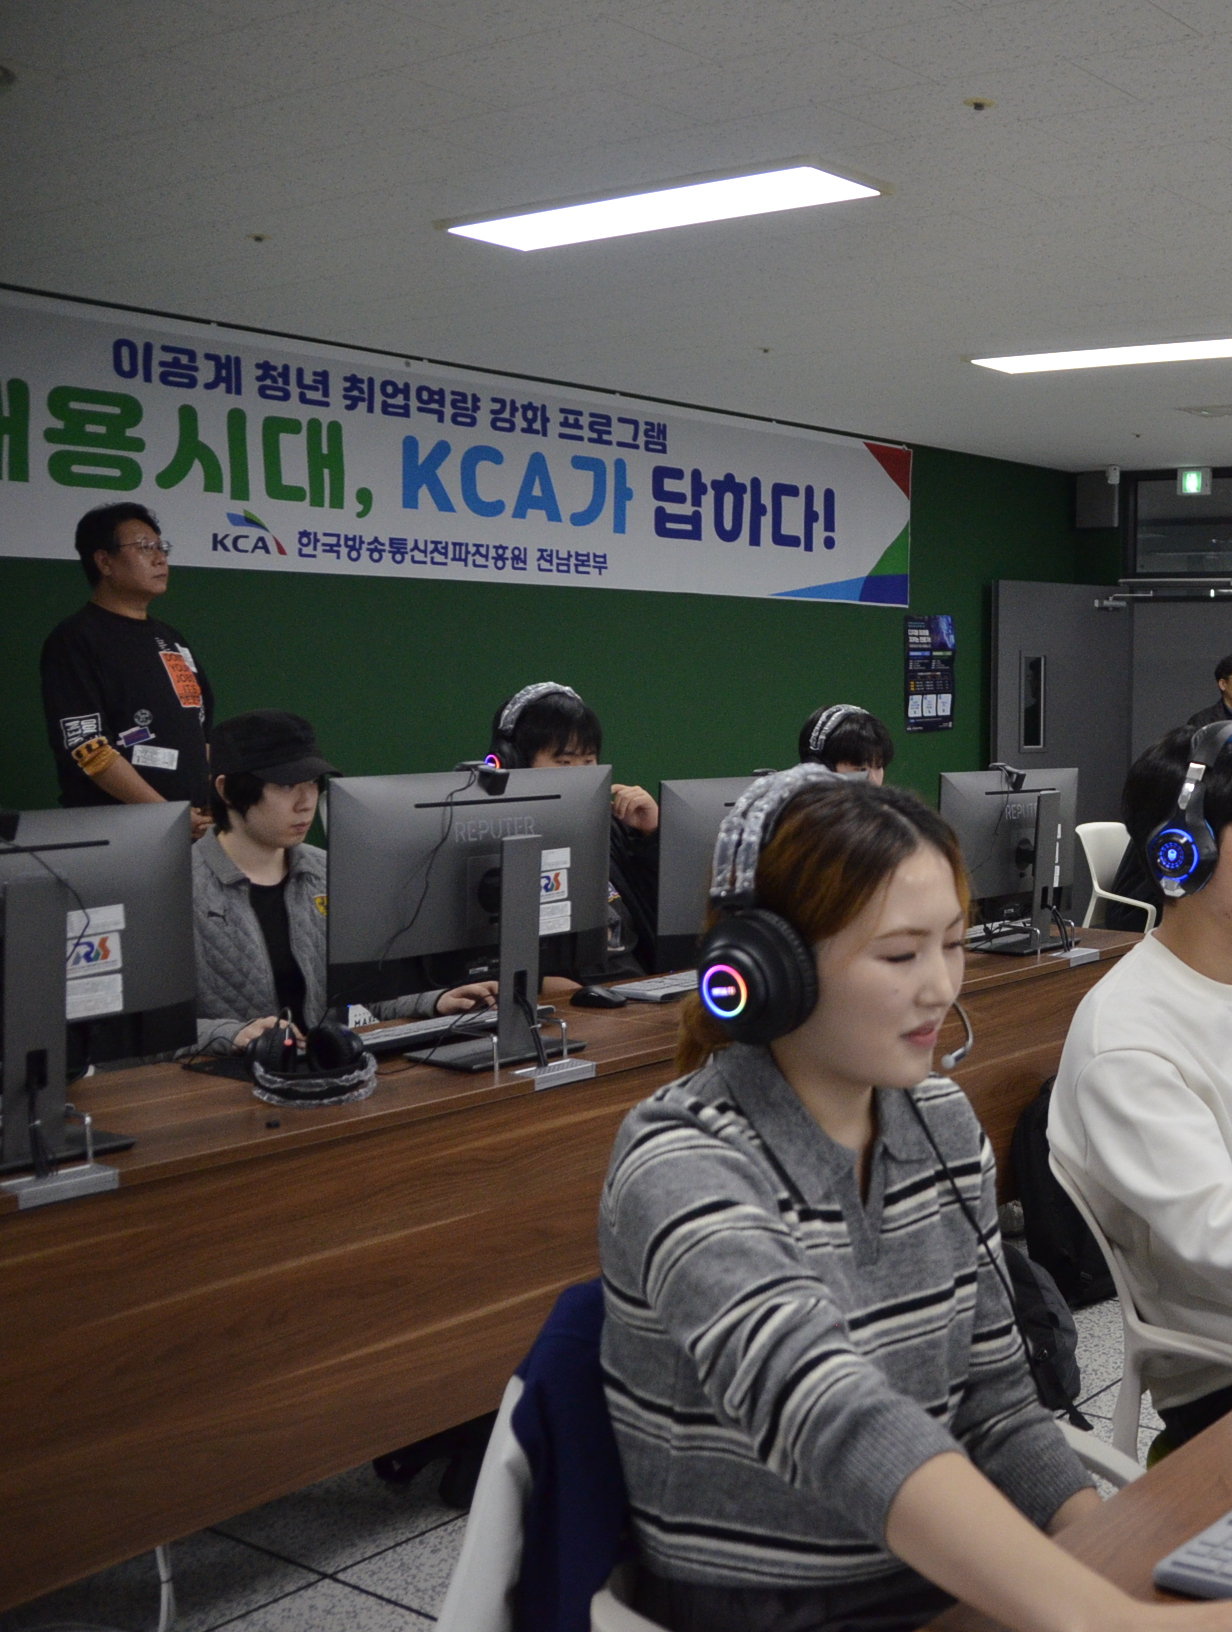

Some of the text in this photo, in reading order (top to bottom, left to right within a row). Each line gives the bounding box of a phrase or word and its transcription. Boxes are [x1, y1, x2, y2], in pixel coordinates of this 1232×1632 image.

[112, 338, 667, 454] 이공계 청년 취업역량 강화 프로그램
[402, 435, 634, 534] KCA가
[652, 465, 835, 552] 답하다!
[211, 532, 272, 555] KCA
[297, 529, 608, 575] 한국방송통신전파진흥원 전남본부
[455, 815, 535, 843] REPUTER
